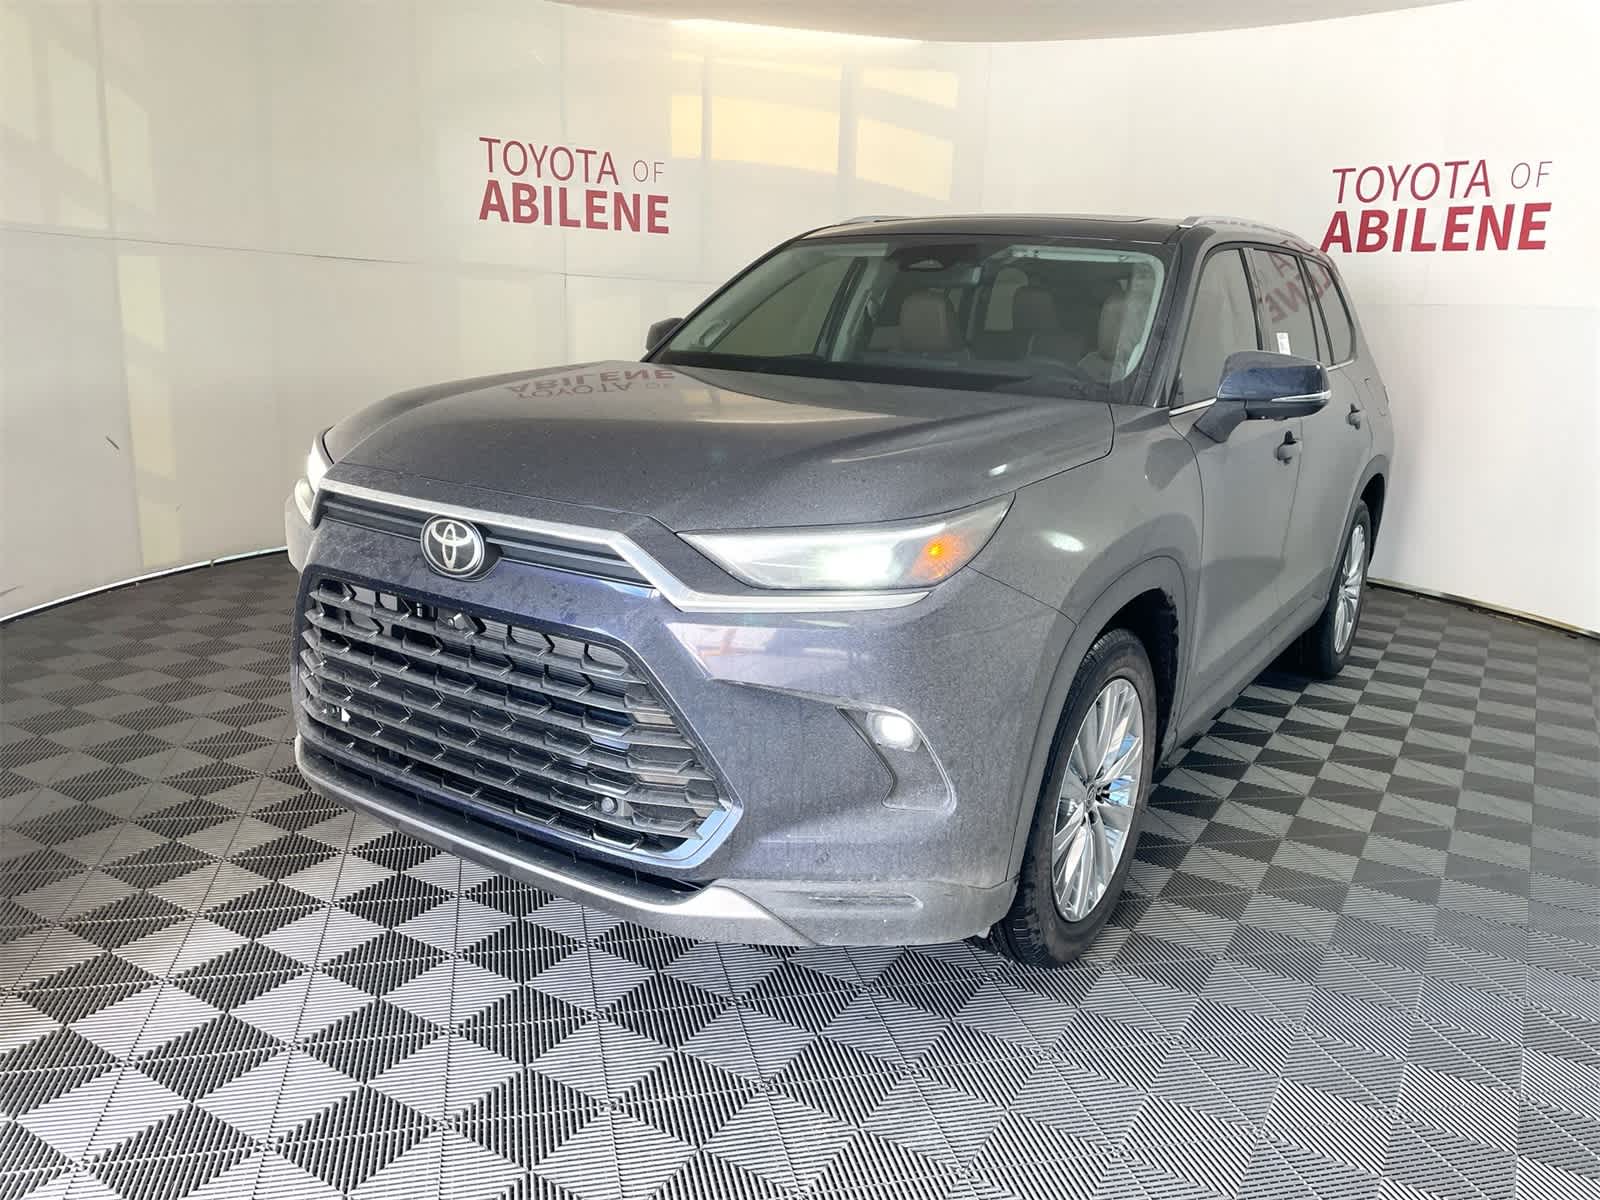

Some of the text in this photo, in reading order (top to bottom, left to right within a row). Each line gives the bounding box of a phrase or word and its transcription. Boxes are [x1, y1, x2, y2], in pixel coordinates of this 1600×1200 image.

[479, 137, 665, 185] TOYOTA OF
[1332, 159, 1553, 203] TOYOTA OF
[479, 179, 669, 234] ABILENE
[1319, 202, 1552, 253] ABILENE
